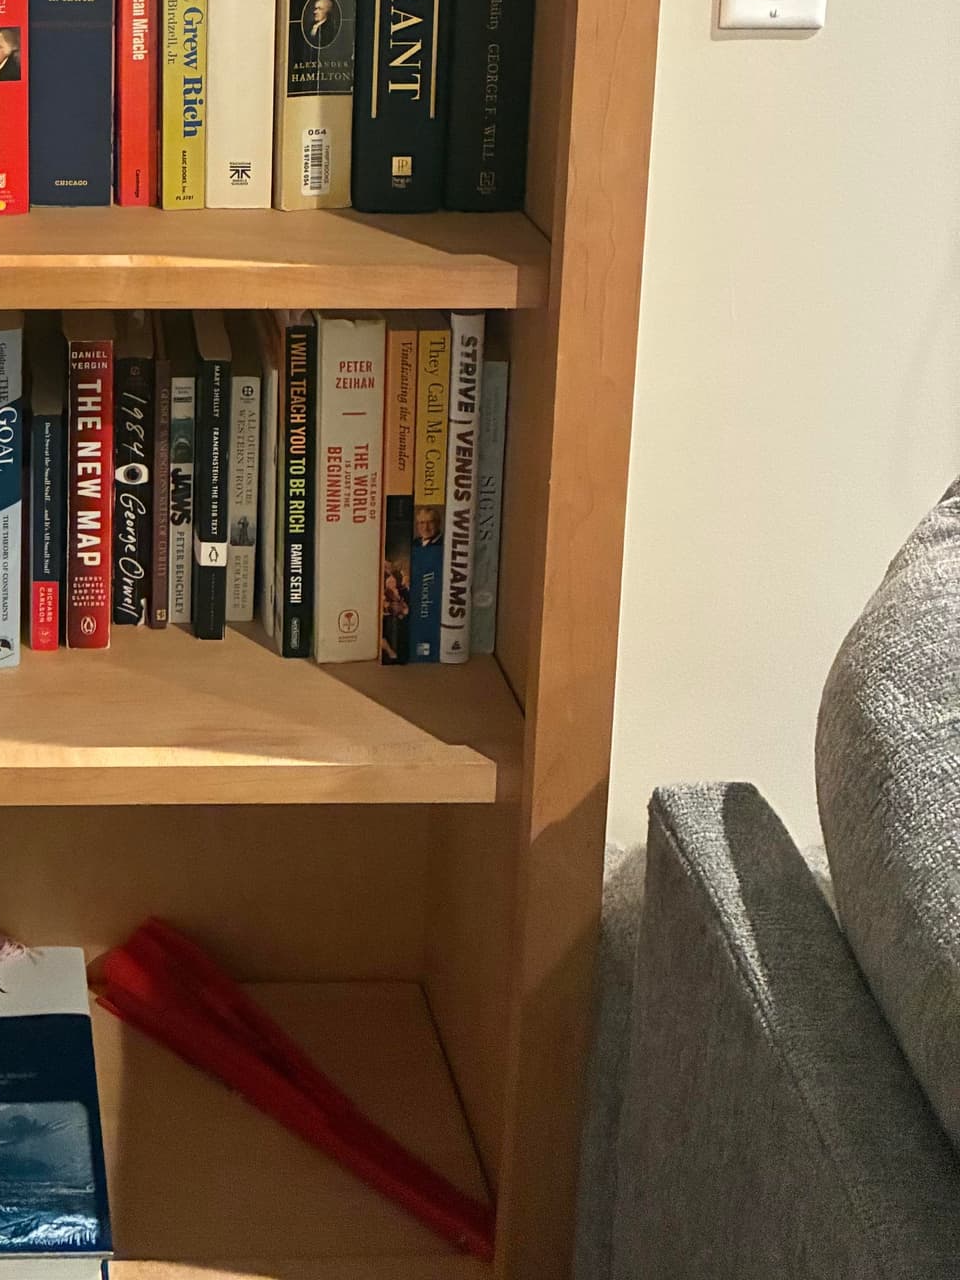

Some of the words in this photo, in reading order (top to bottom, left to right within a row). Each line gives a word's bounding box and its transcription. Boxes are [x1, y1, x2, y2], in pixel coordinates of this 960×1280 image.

[133, 18, 149, 61] Miracle
[183, 7, 204, 71] Grew
[183, 75, 203, 138] Rich
[72, 351, 107, 359] DANIEL
[72, 361, 108, 369] YERGIN
[290, 343, 307, 374] WILL
[339, 361, 372, 372] PETER
[425, 336, 446, 373] They
[458, 335, 478, 412] STRIVE
[290, 378, 307, 416] TEACH
[336, 377, 375, 389] ZEIHAN
[425, 379, 440, 407] Call
[77, 379, 102, 431] THE
[122, 392, 147, 458] 1984
[290, 419, 306, 452] YOU
[425, 417, 440, 442] Me
[77, 441, 101, 499] NEW
[290, 456, 305, 471] TO
[354, 443, 368, 470] THE
[423, 447, 440, 497] Coach
[453, 431, 475, 501] VENUS
[171, 467, 191, 527] JAWS
[290, 474, 305, 494] BE
[326, 446, 342, 523] BEGINNING
[353, 473, 368, 524] WORLD
[120, 493, 146, 553] George
[289, 498, 305, 534] RICH
[76, 511, 101, 567] MAP
[175, 531, 185, 561] PETER
[290, 543, 302, 574] RAMIT
[445, 509, 471, 618] WILLIAMS
[117, 557, 144, 617] Orwell
[174, 563, 184, 615] BENCHLEY
[290, 576, 302, 603] SETHI
